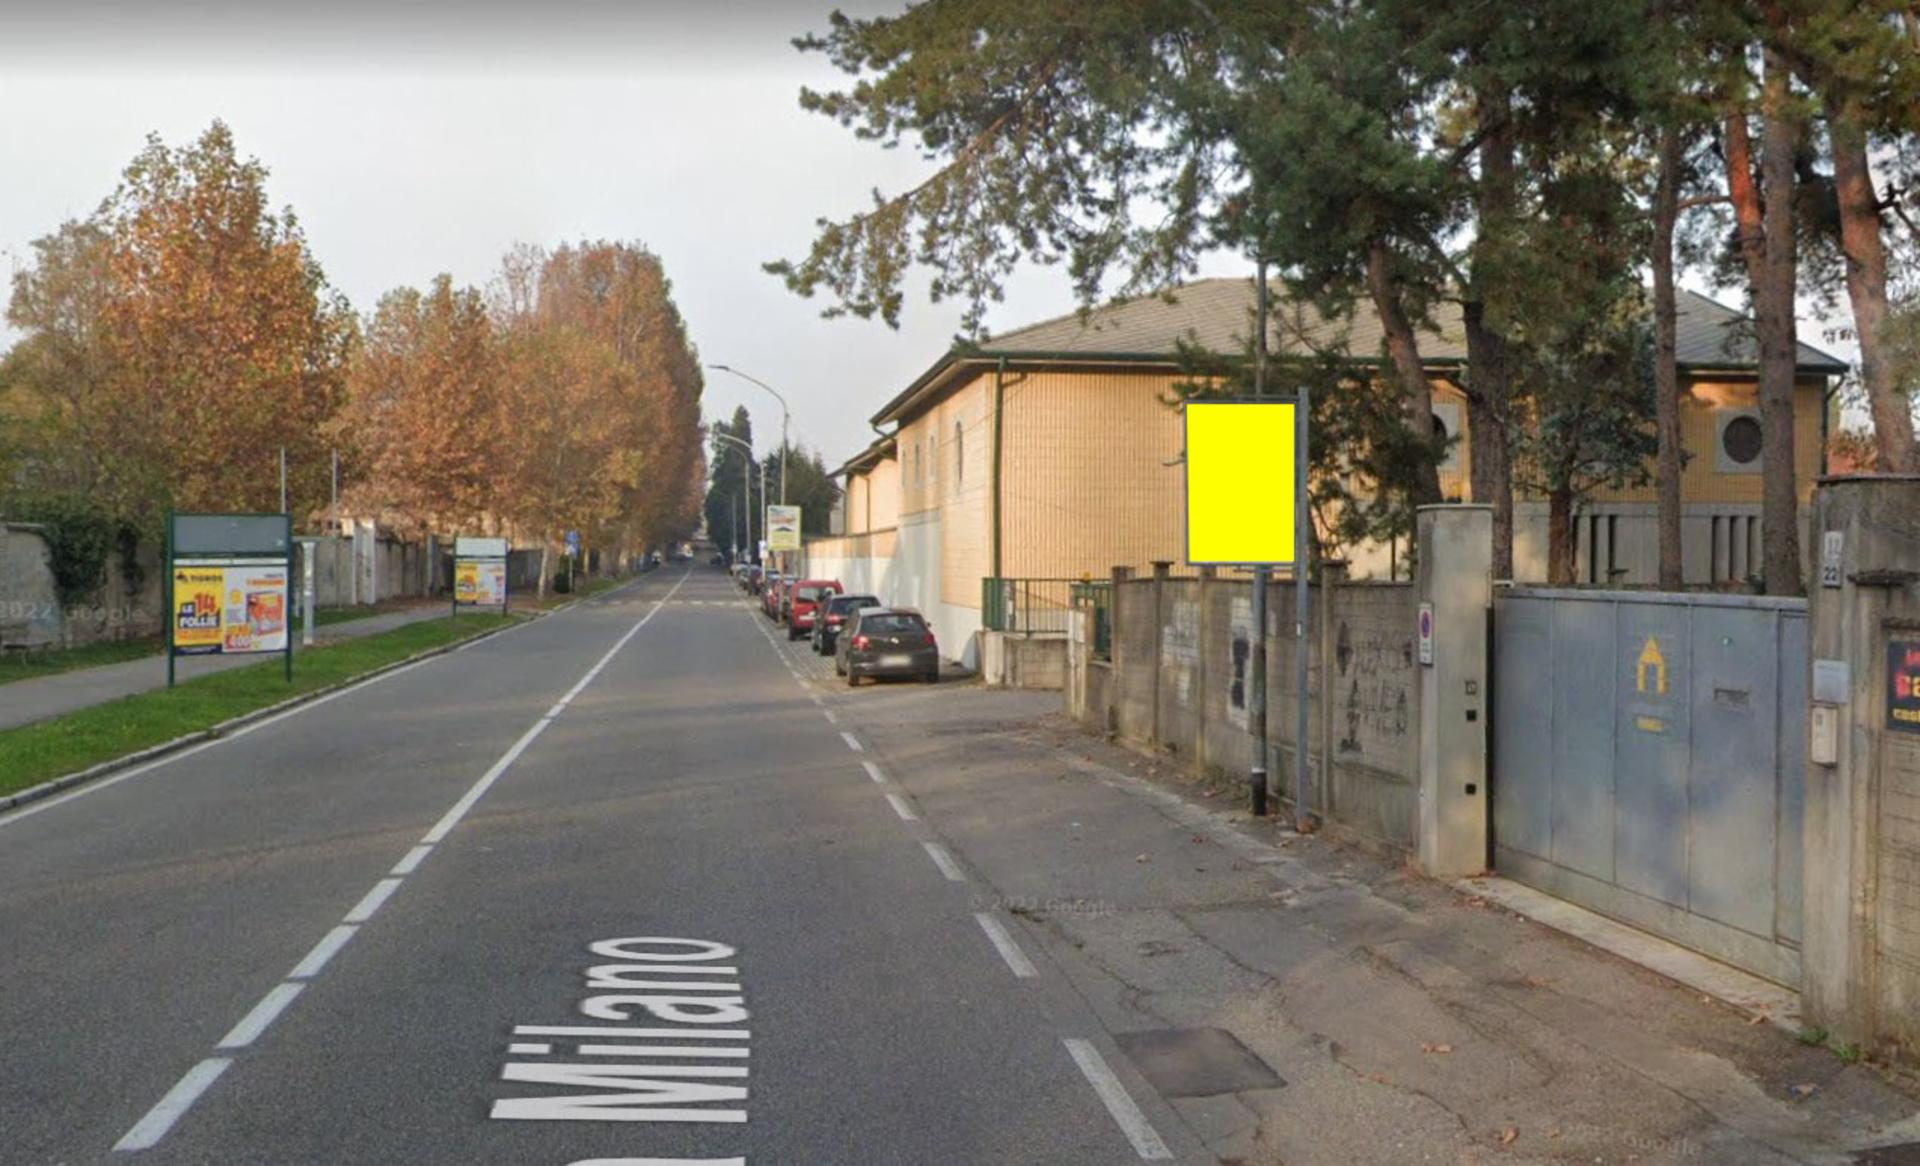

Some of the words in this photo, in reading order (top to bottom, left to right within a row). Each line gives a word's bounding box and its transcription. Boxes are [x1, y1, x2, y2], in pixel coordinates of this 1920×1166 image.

[1824, 566, 1838, 581] 22
[181, 604, 193, 614] LE
[180, 616, 217, 628] FOLLIE
[490, 937, 750, 1122] Milano
